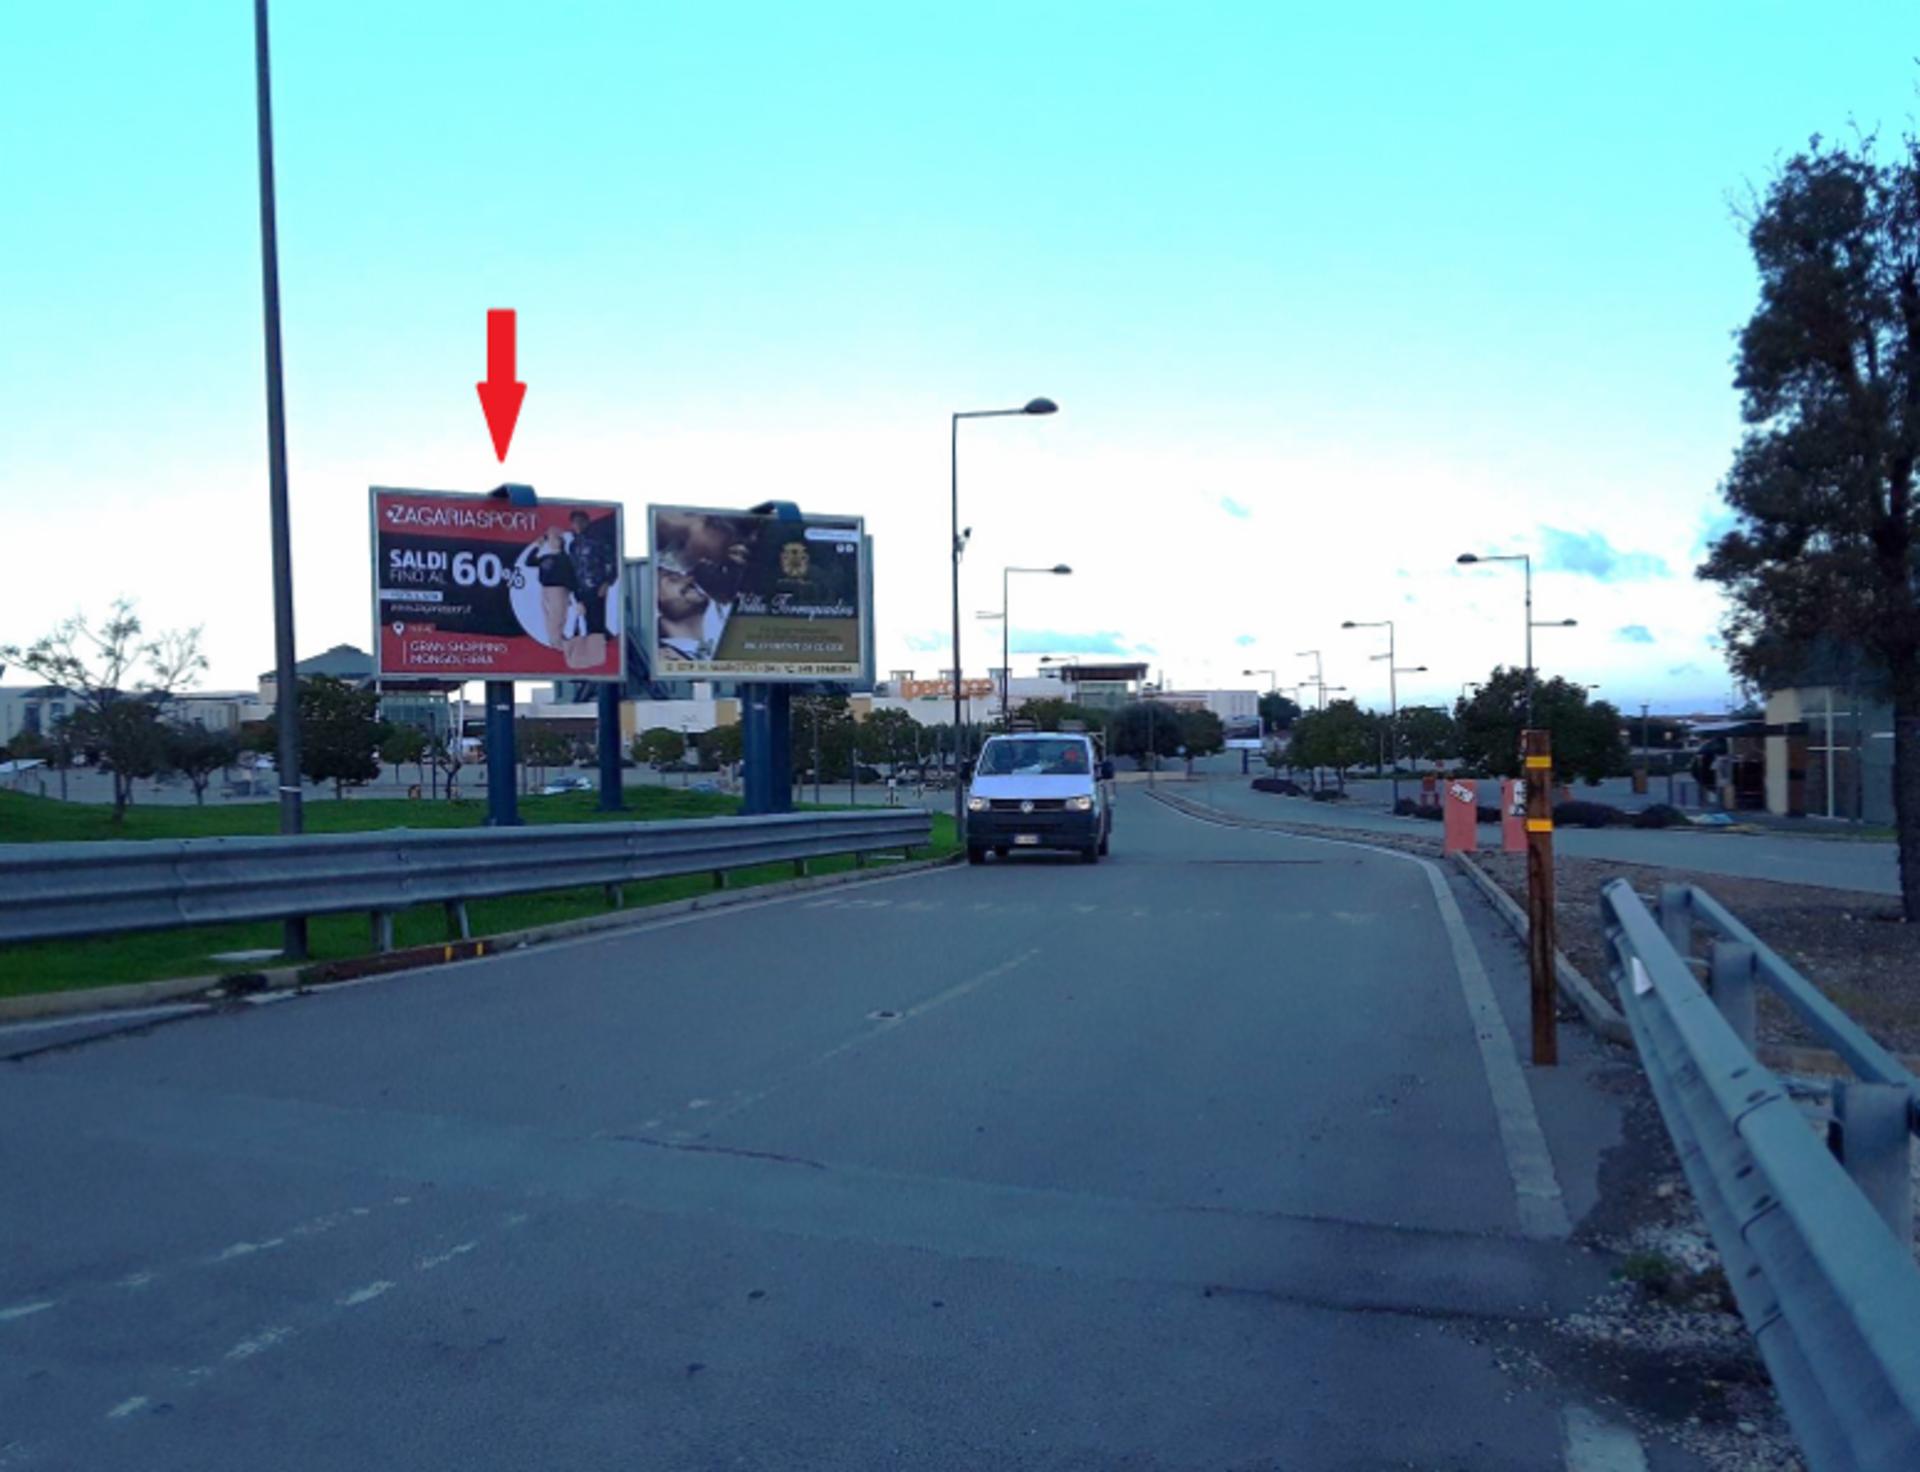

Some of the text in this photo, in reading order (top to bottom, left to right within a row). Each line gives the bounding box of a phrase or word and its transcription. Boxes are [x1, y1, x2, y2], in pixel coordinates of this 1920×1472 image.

[392, 504, 538, 531] ZAGARIASPORT
[390, 549, 447, 570] SALDI
[452, 551, 526, 588] 60%
[390, 569, 448, 584] FINO AL
[410, 640, 508, 654] GRAN SHOPPING
